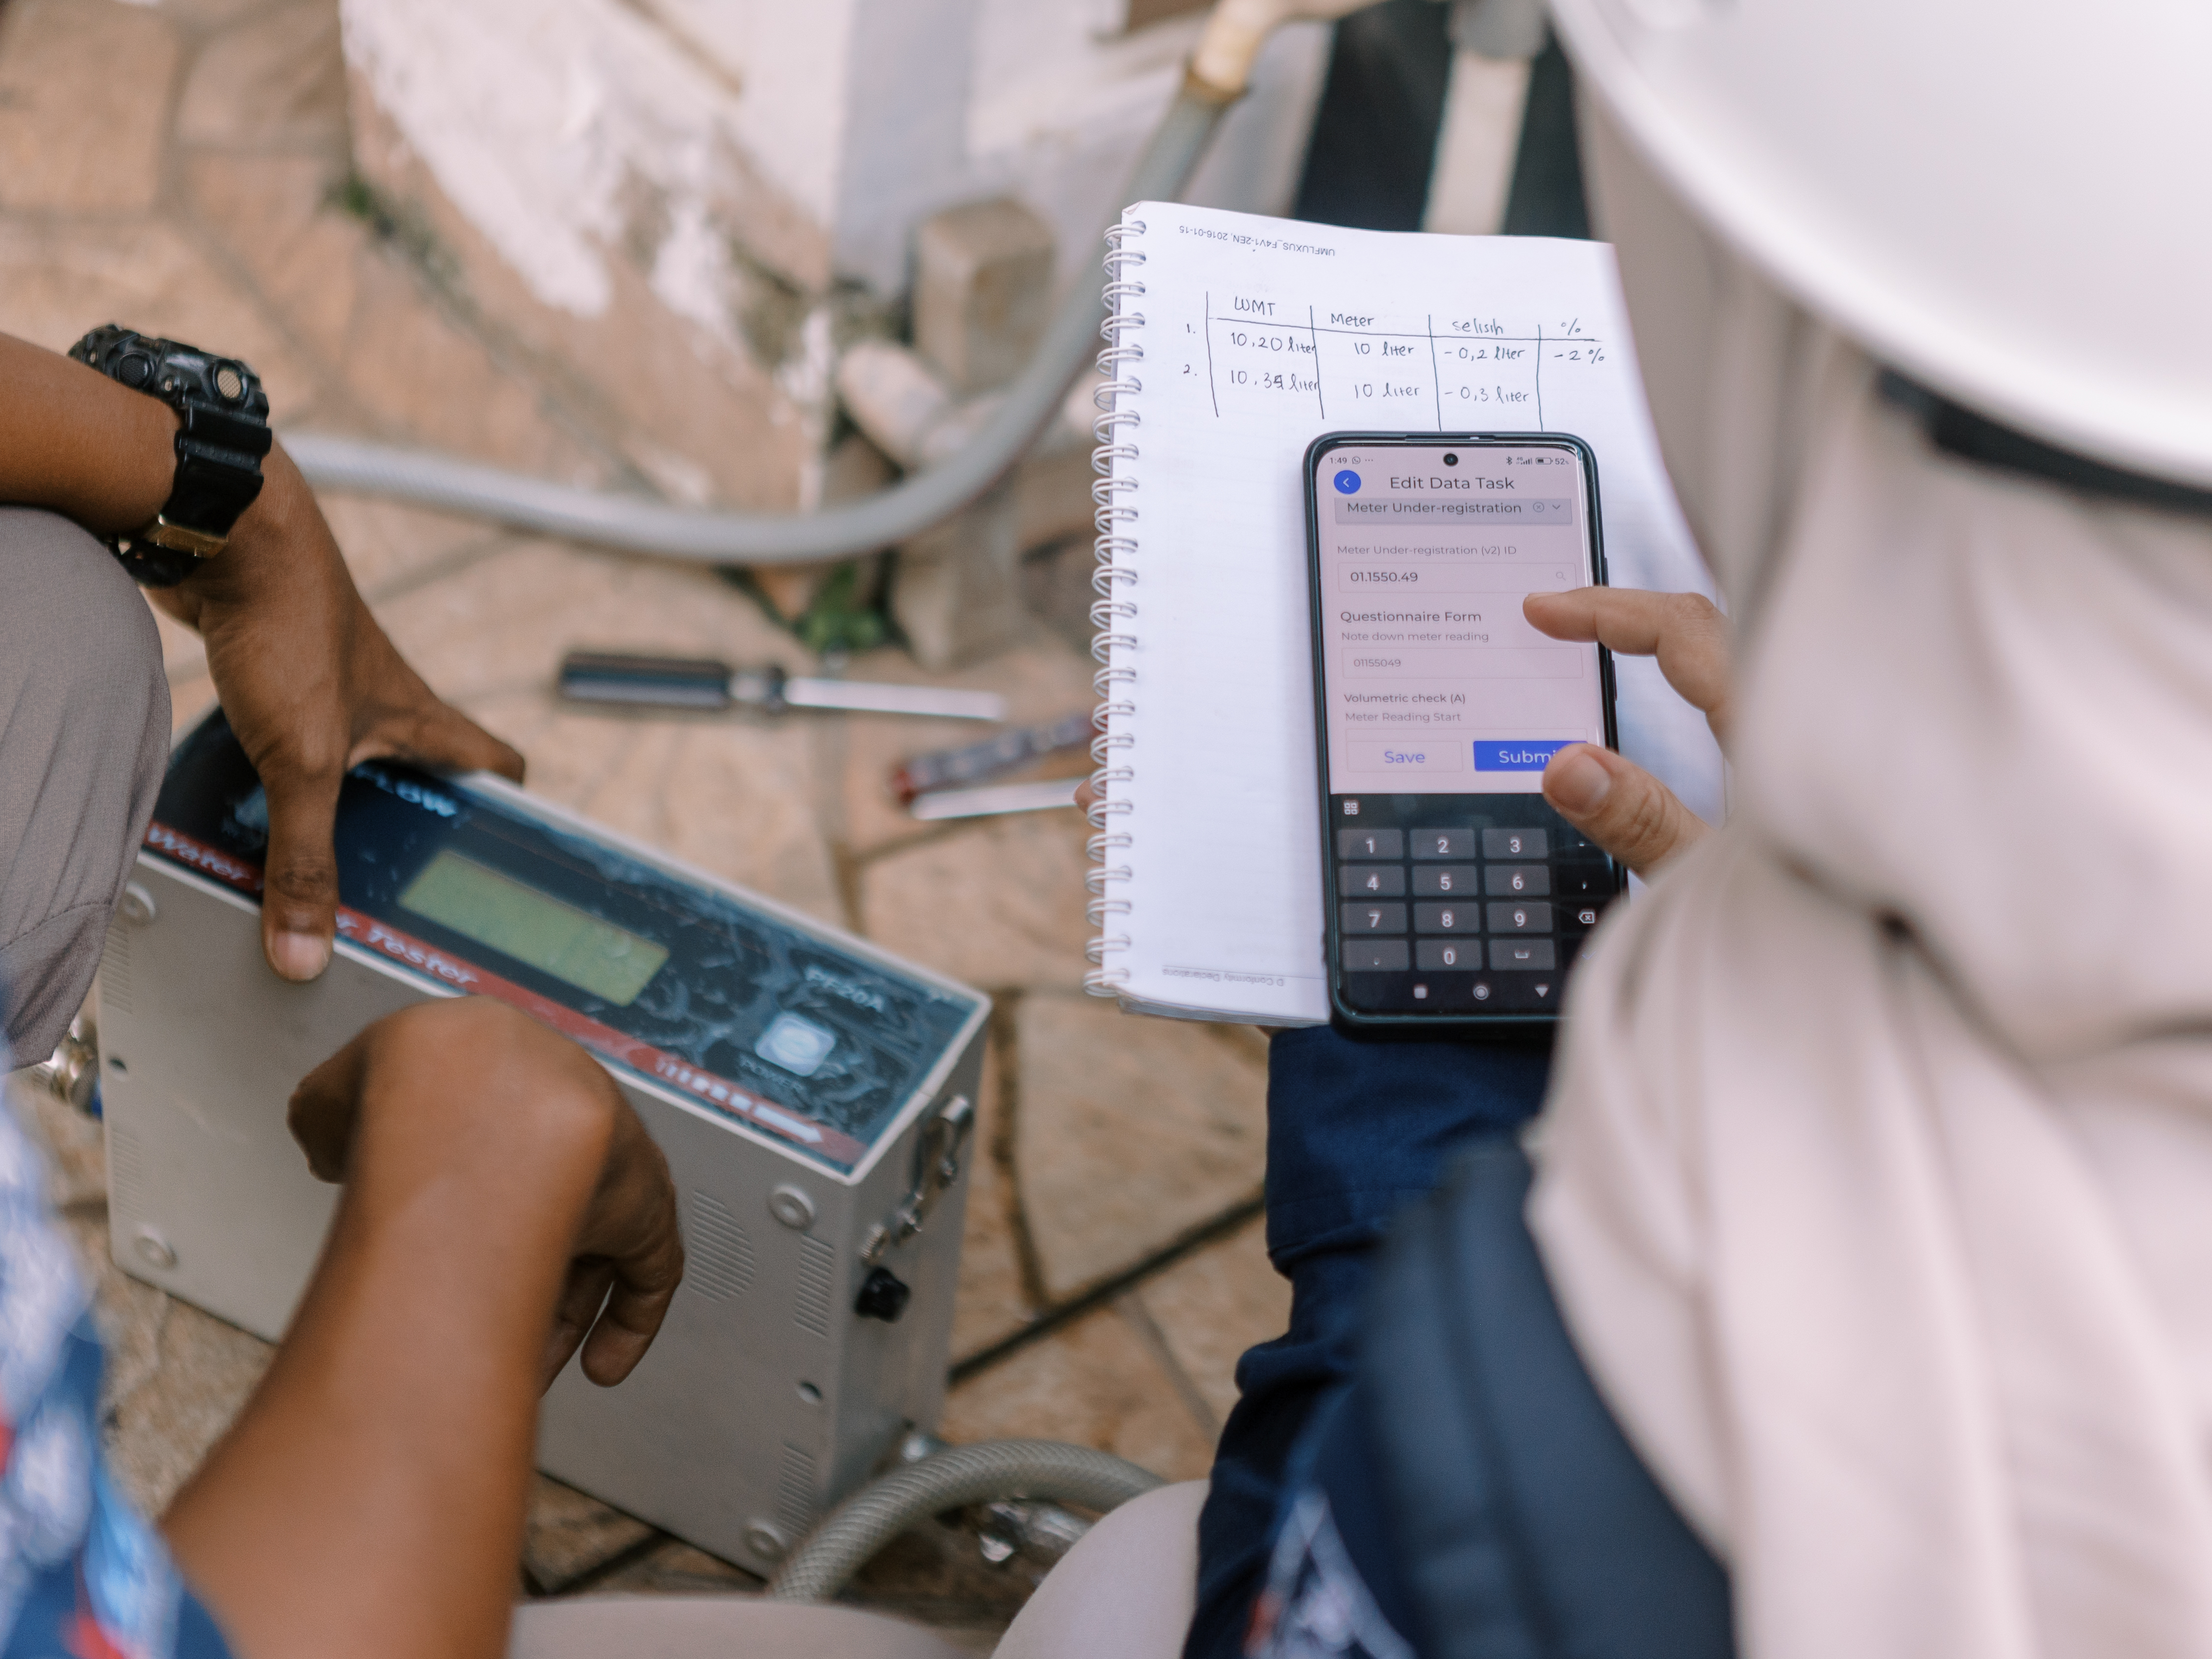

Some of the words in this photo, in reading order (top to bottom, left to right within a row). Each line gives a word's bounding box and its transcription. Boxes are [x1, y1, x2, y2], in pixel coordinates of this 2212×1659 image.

[1179, 226, 1228, 240] 2016-01-15
[1235, 296, 1276, 316] WMT
[1331, 313, 1374, 326] Meter
[1561, 318, 1581, 335] %
[1187, 323, 1195, 333] 1.
[1355, 343, 1370, 354] 10
[1382, 341, 1414, 356] liter
[1494, 346, 1525, 360] liter
[1183, 364, 1197, 376] 2.
[1355, 384, 1372, 399] 10
[1383, 382, 1420, 397] liter
[1496, 386, 1530, 404] liter
[1330, 457, 1347, 465] 1:49
[1390, 476, 1424, 491] Edit
[1430, 476, 1470, 491] Data
[1475, 476, 1515, 491] Task
[1347, 502, 1388, 514] Meter
[1393, 502, 1522, 517] Under-registration
[1338, 545, 1370, 555] Meter
[1373, 546, 1478, 557] Under-registration
[1481, 546, 1501, 557] (v2)
[1504, 546, 1517, 555] ID
[1350, 571, 1419, 583] 01.1550.49
[1340, 611, 1440, 624] Questionnaire
[1445, 611, 1482, 622] Form
[1341, 632, 1368, 641] Note
[1372, 632, 1404, 641] down
[1446, 632, 1489, 643] reading
[1353, 658, 1401, 668] 01155049
[1344, 694, 1408, 703] Volumetric
[1412, 693, 1447, 703] check
[1450, 693, 1466, 704] (A)
[1345, 712, 1378, 722] Meter
[1382, 712, 1430, 724] Reading
[1433, 712, 1462, 722] Start
[1384, 751, 1426, 764] Save
[1366, 839, 1374, 853] 1
[1437, 840, 1449, 853] 2
[1510, 839, 1520, 853] 3
[148, 827, 251, 880] Water
[1367, 877, 1379, 890] 4
[1440, 877, 1452, 890] 5
[1512, 876, 1523, 890] 6
[1369, 913, 1380, 928] 7
[1441, 913, 1454, 928] 8
[1513, 912, 1526, 927] 9
[366, 923, 479, 984] Tester
[1443, 950, 1456, 965] 0
[1162, 969, 1220, 982] Declarations
[1224, 973, 1274, 986] Conformity
